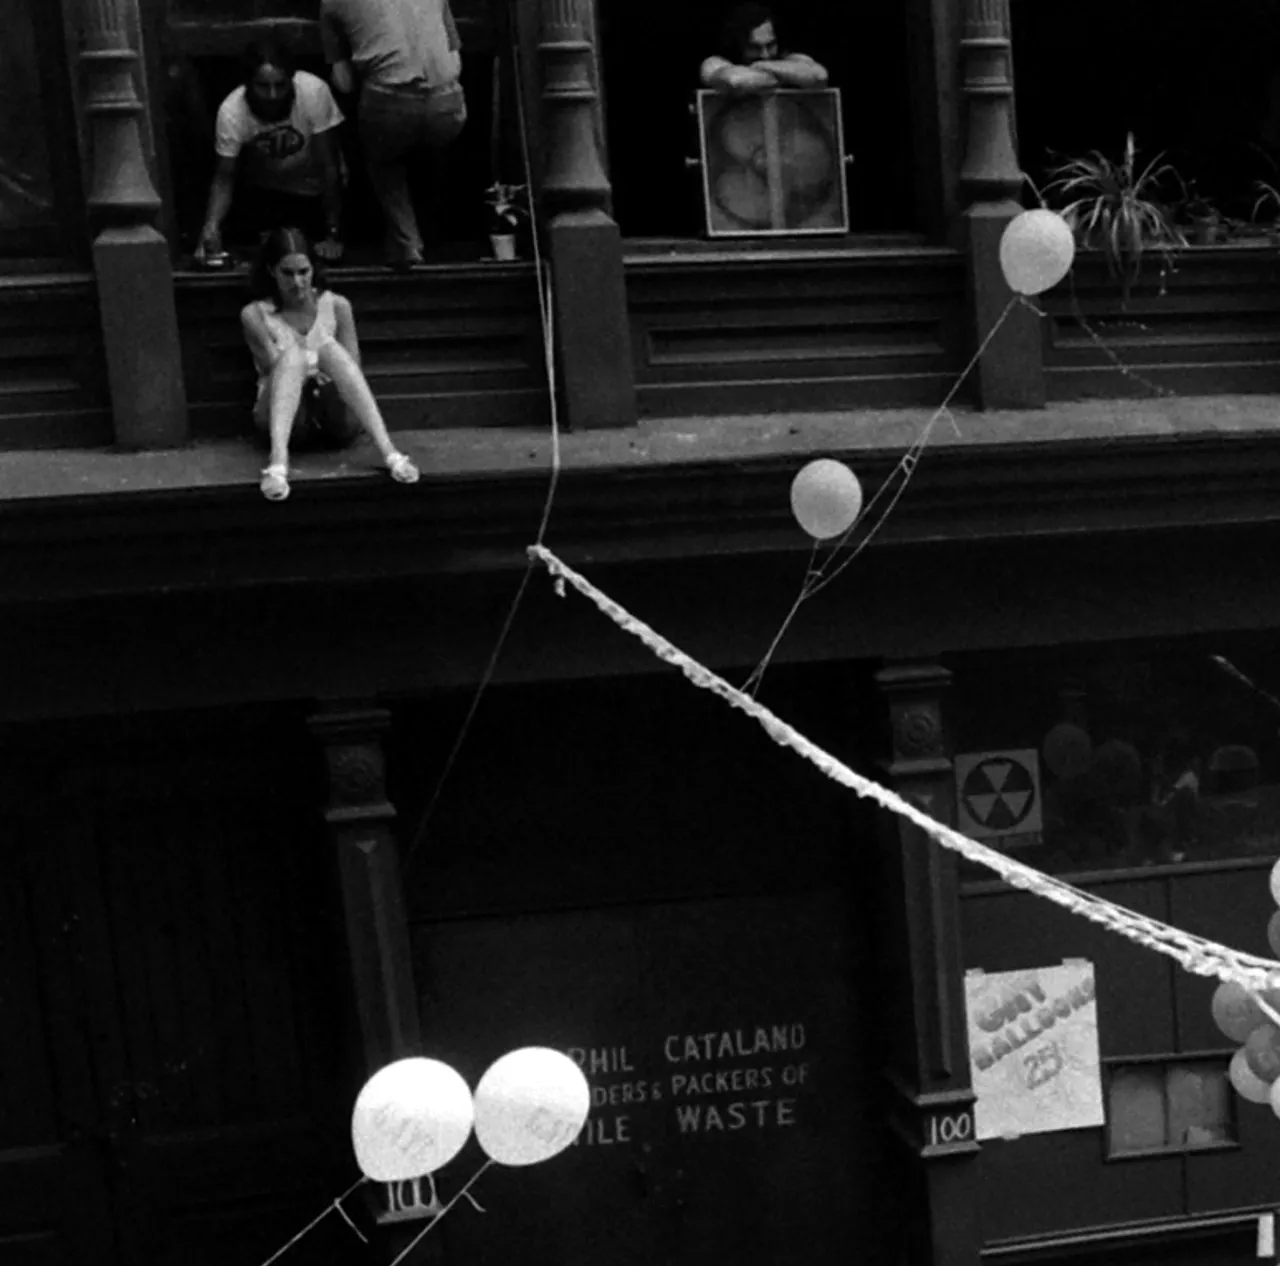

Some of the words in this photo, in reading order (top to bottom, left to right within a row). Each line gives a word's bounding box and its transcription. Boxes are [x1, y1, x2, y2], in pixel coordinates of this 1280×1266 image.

[974, 979, 1046, 1033] GAY
[664, 1022, 806, 1063] CATALAND
[591, 1080, 647, 1107] DERS
[671, 1065, 773, 1096] PACKERS
[781, 1062, 811, 1086] OF
[571, 1114, 632, 1146] ILE
[675, 1099, 798, 1133] WASTE
[931, 1112, 971, 1147] 100
